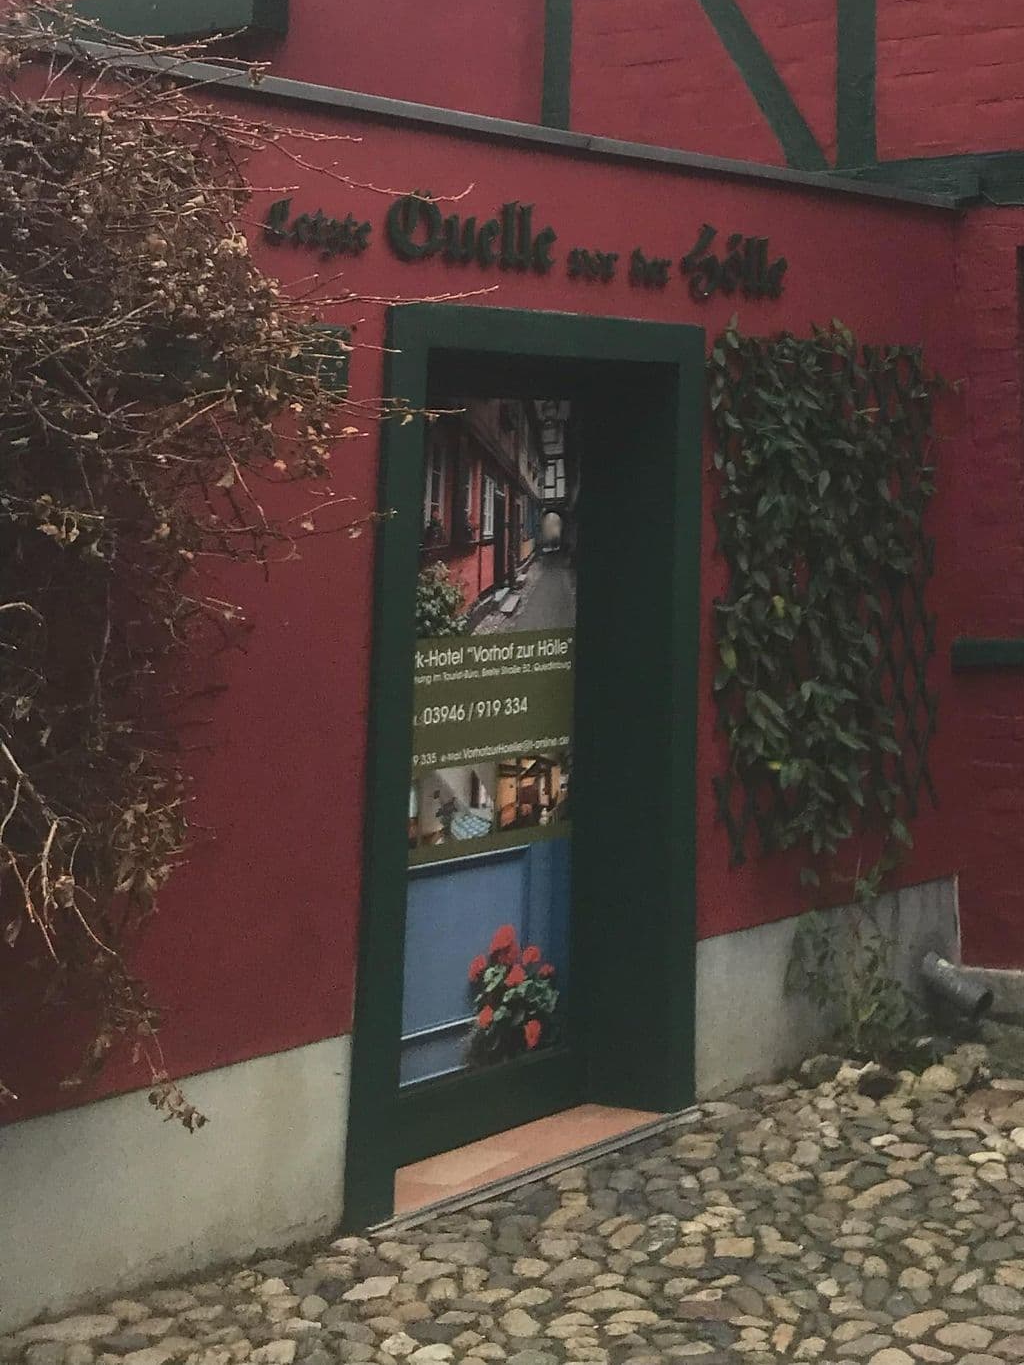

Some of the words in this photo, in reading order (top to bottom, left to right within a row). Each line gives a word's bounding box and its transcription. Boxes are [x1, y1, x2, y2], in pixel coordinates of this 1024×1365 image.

[383, 190, 557, 276] Quelle
[566, 246, 620, 285] vor
[629, 246, 673, 289] der
[415, 647, 464, 668] k-Hotel
[516, 642, 535, 659] zur
[423, 704, 466, 725] 03946
[476, 699, 502, 718] 919
[504, 696, 529, 716] 334
